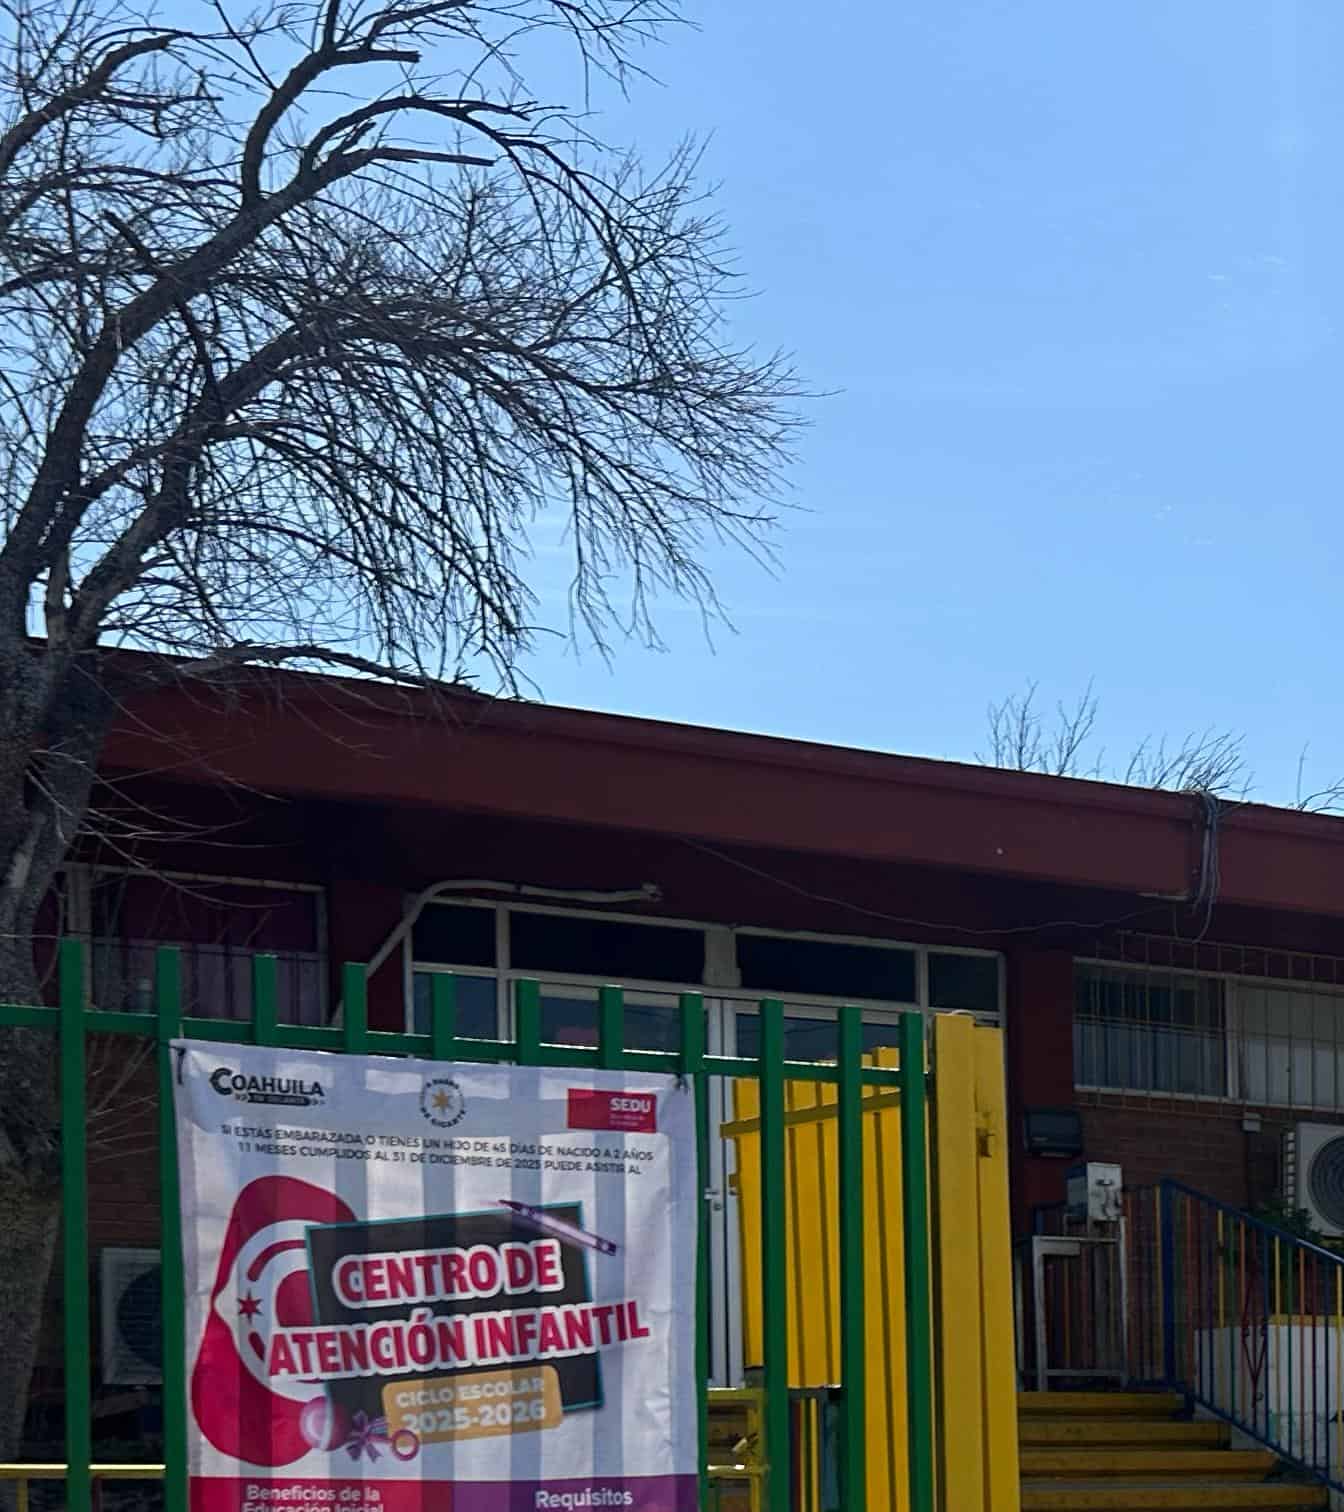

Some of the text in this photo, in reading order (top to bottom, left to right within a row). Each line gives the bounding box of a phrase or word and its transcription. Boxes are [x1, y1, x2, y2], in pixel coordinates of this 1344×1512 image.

[209, 1068, 325, 1097] COAHUILA
[610, 1097, 651, 1113] SEDU
[238, 1142, 251, 1152] 11
[255, 1143, 297, 1156] MESES
[300, 1146, 371, 1160] CUMPLIDOS
[375, 1150, 390, 1161] AL
[410, 1152, 426, 1163] DE
[430, 1153, 492, 1167] DICIEMBRE
[496, 1157, 512, 1168] DE
[514, 1158, 541, 1169] 2025
[545, 1160, 583, 1171] PUEDE
[585, 1161, 625, 1173] ASISTIR
[628, 1165, 642, 1175] AL
[275, 1129, 362, 1144] EMBARAZADA
[367, 1135, 375, 1145] O
[378, 1135, 420, 1147] TIENES
[424, 1138, 440, 1149] UN
[474, 1141, 489, 1152] DE
[492, 1143, 506, 1153] 45
[537, 1145, 553, 1156] DE
[557, 1146, 601, 1158] NACIDO
[603, 1148, 612, 1158] A
[613, 1148, 620, 1159] 2
[623, 1147, 654, 1161] AÑOS
[337, 1245, 559, 1302] CENTRO DE
[268, 1301, 649, 1377] ATENCIÓN INFANTIL
[396, 1377, 545, 1408] CICLO ESCOLAR
[401, 1398, 547, 1433] 2025-2026
[247, 1484, 381, 1501] Beneficios de la
[534, 1487, 633, 1511] Requisitos
